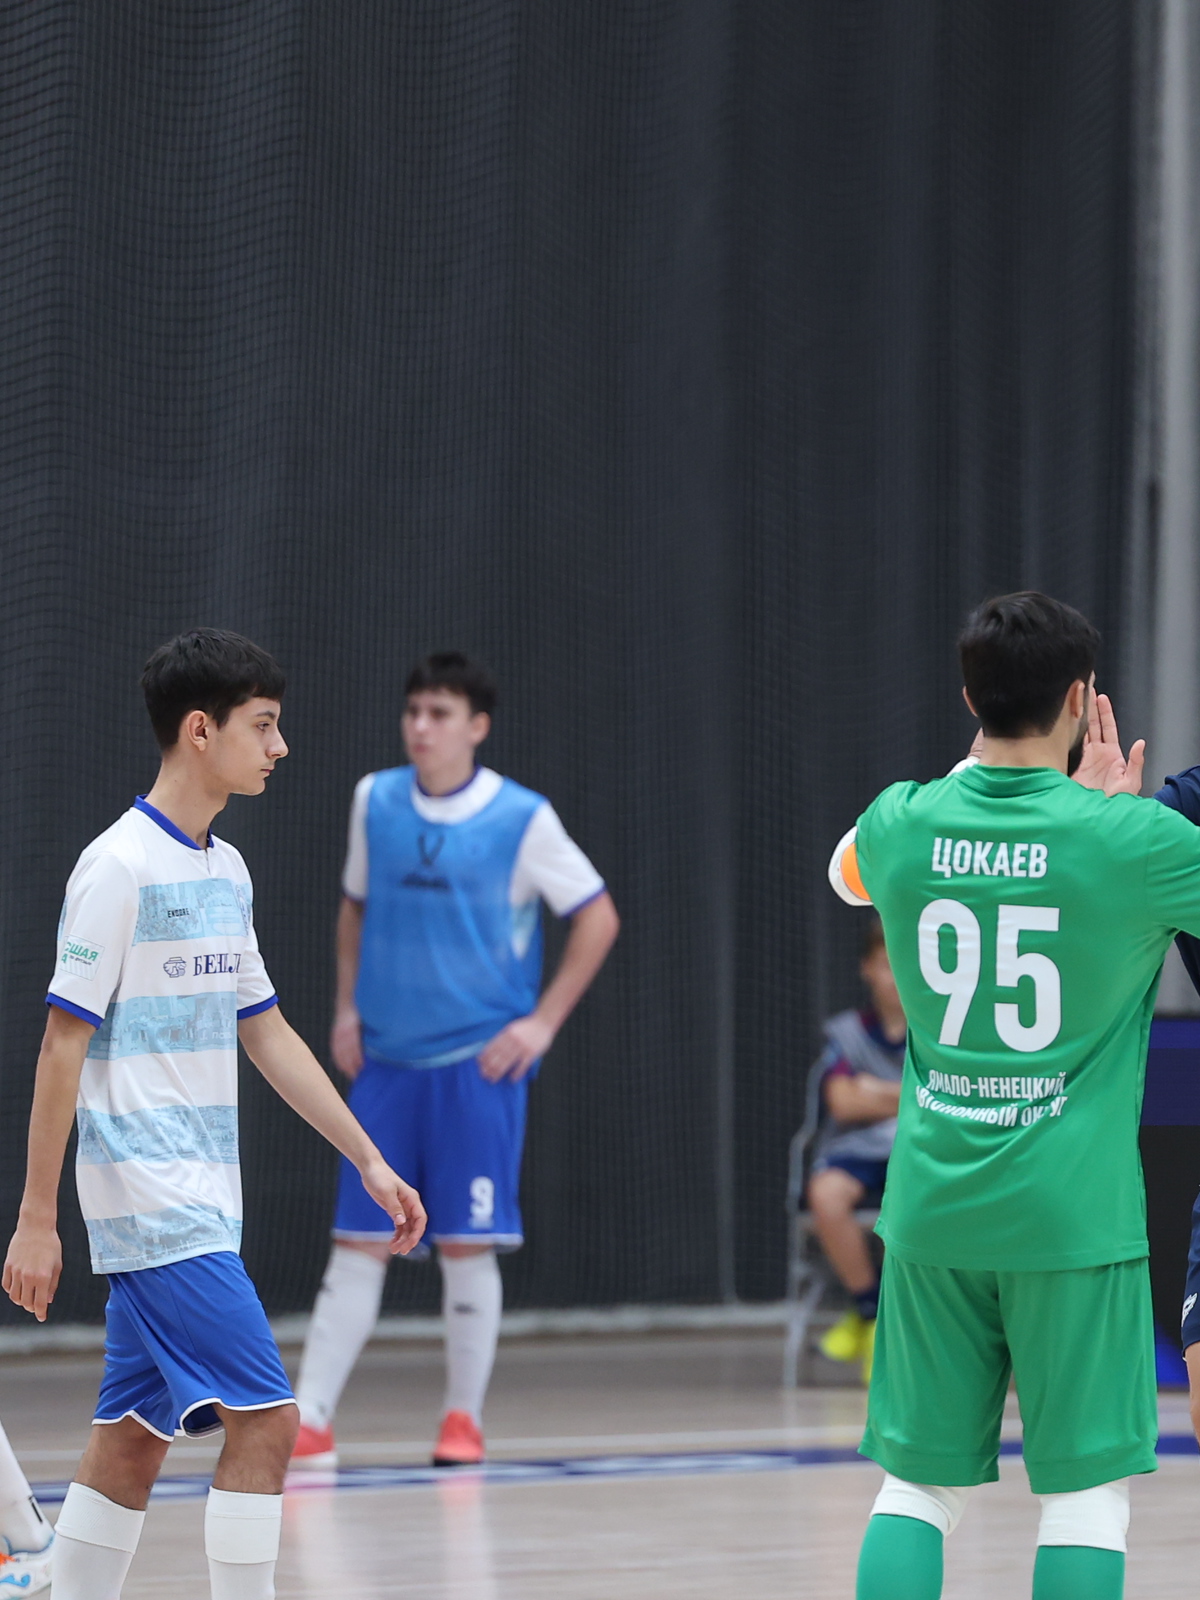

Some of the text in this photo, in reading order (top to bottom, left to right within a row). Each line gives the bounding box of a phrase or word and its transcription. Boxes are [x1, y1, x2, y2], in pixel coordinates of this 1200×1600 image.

[931, 836, 1049, 879] ЦОКАЕВ
[917, 898, 1062, 1053] 95
[927, 1070, 1067, 1102] ЯМАЛО-НЕНЕЦКИЙ
[470, 1176, 494, 1215] 9
